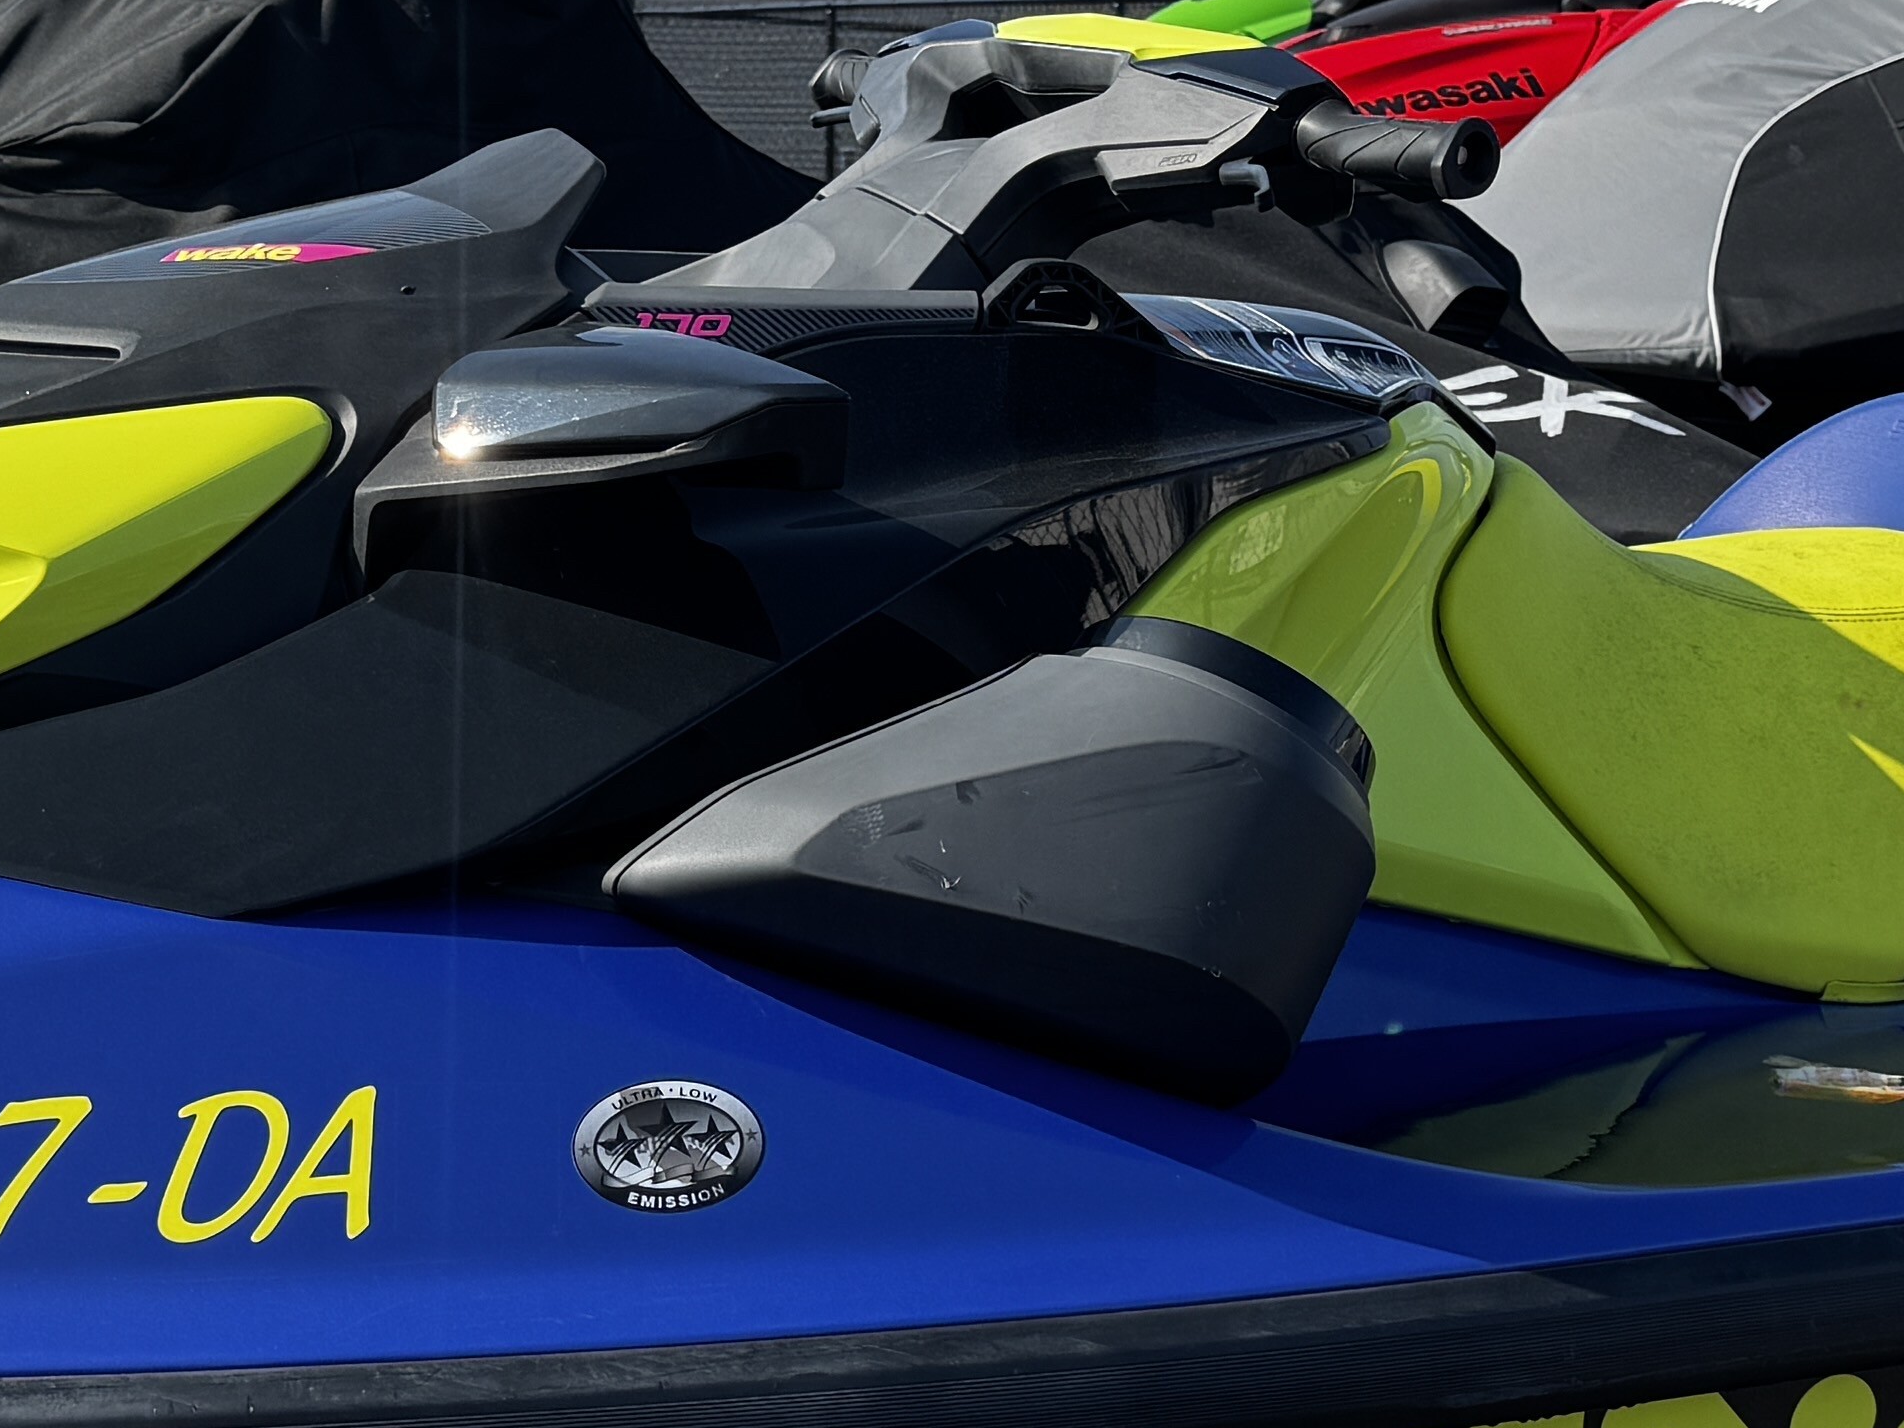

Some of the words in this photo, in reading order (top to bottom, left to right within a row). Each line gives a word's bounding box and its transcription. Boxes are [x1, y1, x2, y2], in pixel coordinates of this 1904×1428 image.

[1352, 67, 1546, 117] wasaki
[175, 242, 302, 262] wake
[636, 312, 732, 338] 170
[611, 1086, 665, 1111] ULTRA
[679, 1086, 718, 1104] LOW
[627, 1183, 726, 1209] EMISSION
